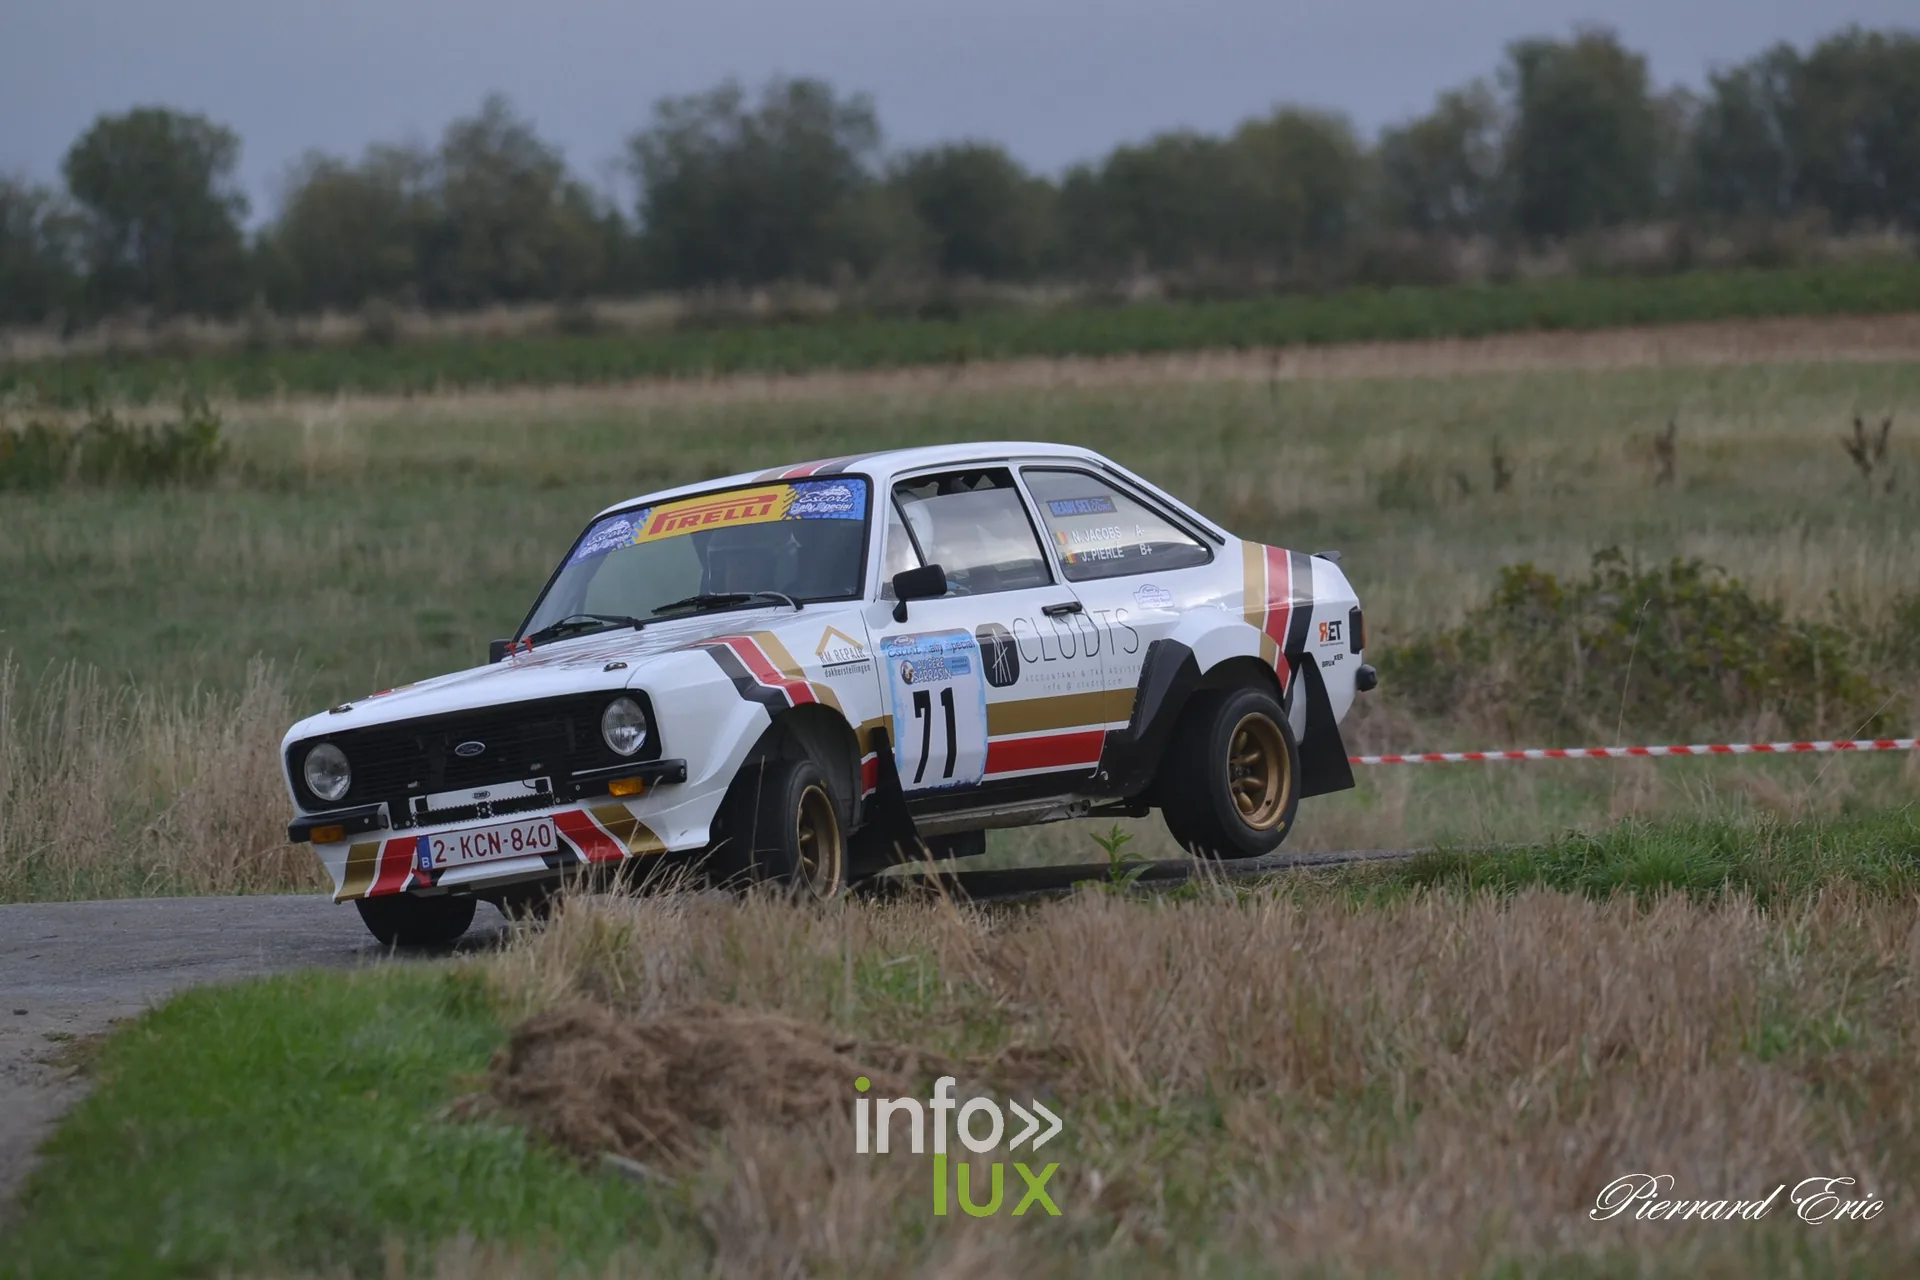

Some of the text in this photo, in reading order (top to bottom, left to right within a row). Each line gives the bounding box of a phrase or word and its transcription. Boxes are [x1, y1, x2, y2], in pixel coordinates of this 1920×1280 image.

[648, 494, 778, 536] PIRELLI
[1084, 526, 1121, 542] JACOBS
[1140, 543, 1152, 556] B+
[824, 664, 871, 678] dakherstellingen
[911, 668, 952, 683] SARRASIN
[1025, 671, 1076, 682] ACCOUNTANT
[913, 687, 957, 784] 71
[421, 824, 551, 868] B 2-KCN-840
